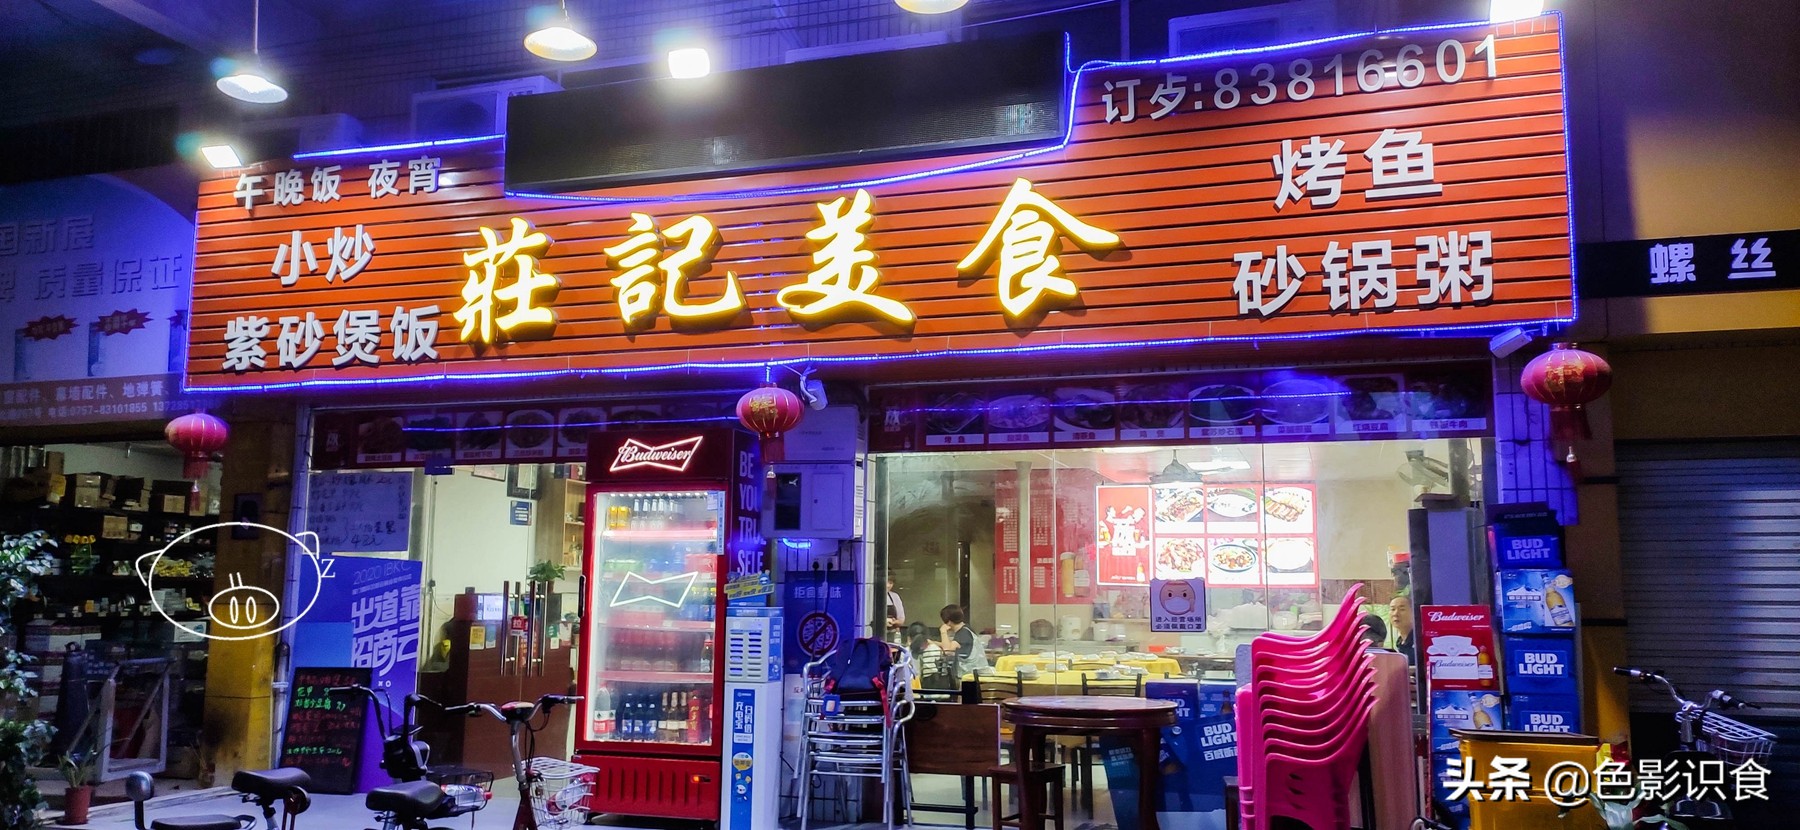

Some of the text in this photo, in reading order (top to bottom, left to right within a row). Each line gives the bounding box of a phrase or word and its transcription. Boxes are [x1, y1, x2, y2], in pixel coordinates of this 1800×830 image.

[233, 156, 441, 210] 午晚饭 夜宵
[1272, 129, 1443, 210] 烤鱼
[271, 225, 376, 286] 小炒
[452, 176, 1121, 344] 莊記美食
[1650, 238, 1777, 284] 螺丝
[34, 254, 182, 300] 质量保证
[1232, 230, 1494, 317] 砂锅粥
[222, 305, 441, 371] 紫砂煲饭
[618, 446, 694, 464] Budweiser
[739, 451, 754, 479] BE
[1506, 548, 1551, 560] LIGHT
[1511, 538, 1544, 550] BUD
[352, 583, 421, 634] 出道靠
[1427, 611, 1485, 623] Budweiser
[352, 628, 419, 677] 招商云
[1434, 659, 1476, 669] Budweiser
[1524, 652, 1558, 664] BUD
[1518, 663, 1565, 675] LIGHT
[1203, 723, 1232, 736] BUD
[1530, 713, 1564, 725] BUD
[1200, 732, 1238, 747] LIGHT
